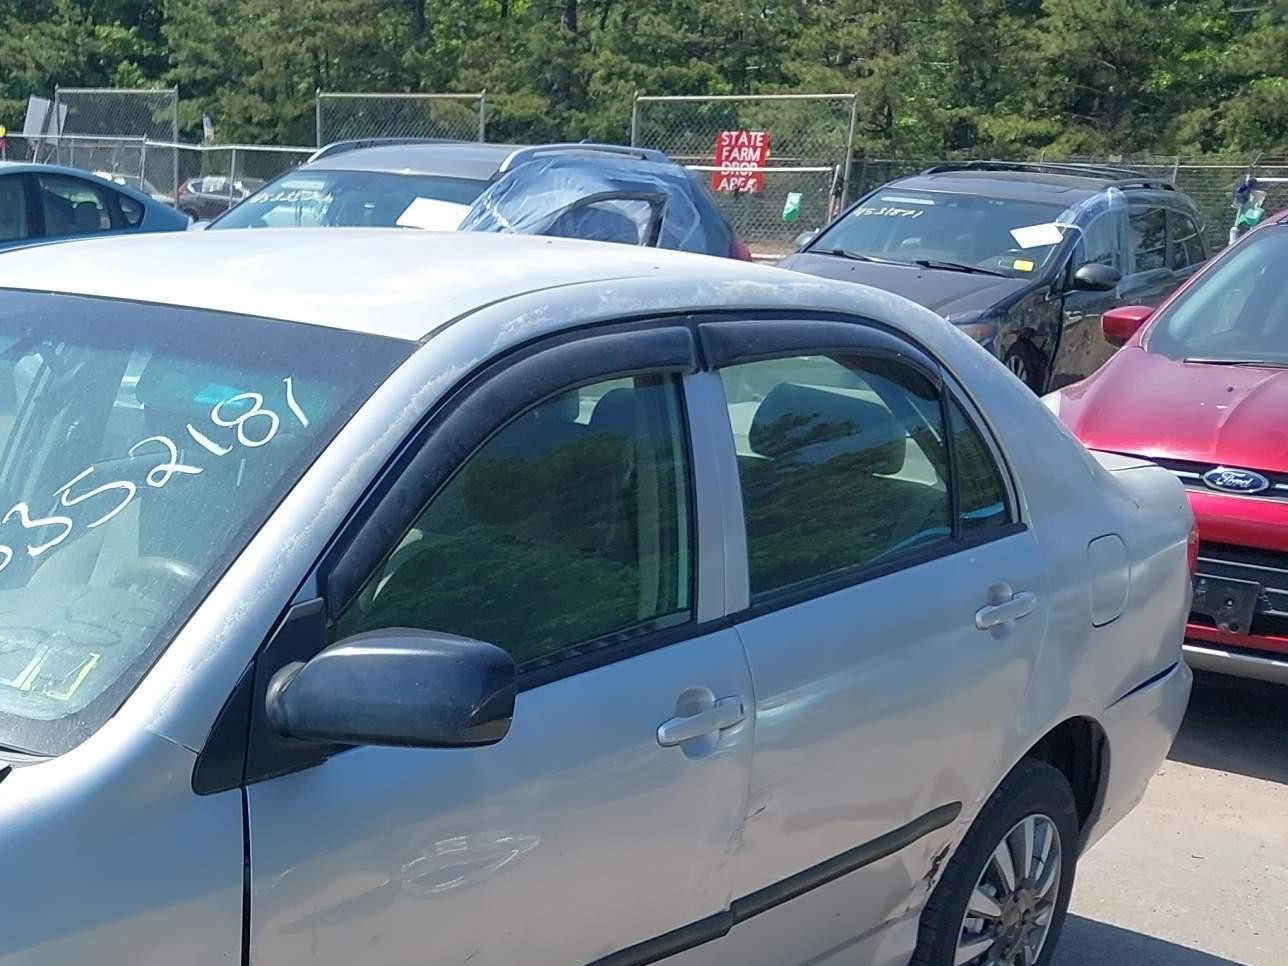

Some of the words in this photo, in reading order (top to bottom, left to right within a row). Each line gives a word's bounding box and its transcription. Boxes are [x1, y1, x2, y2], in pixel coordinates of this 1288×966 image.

[721, 131, 765, 146] STATE
[722, 147, 762, 162] FARM
[721, 161, 759, 176] DROP
[718, 177, 757, 192] AREA
[1215, 471, 1254, 488] Ford
